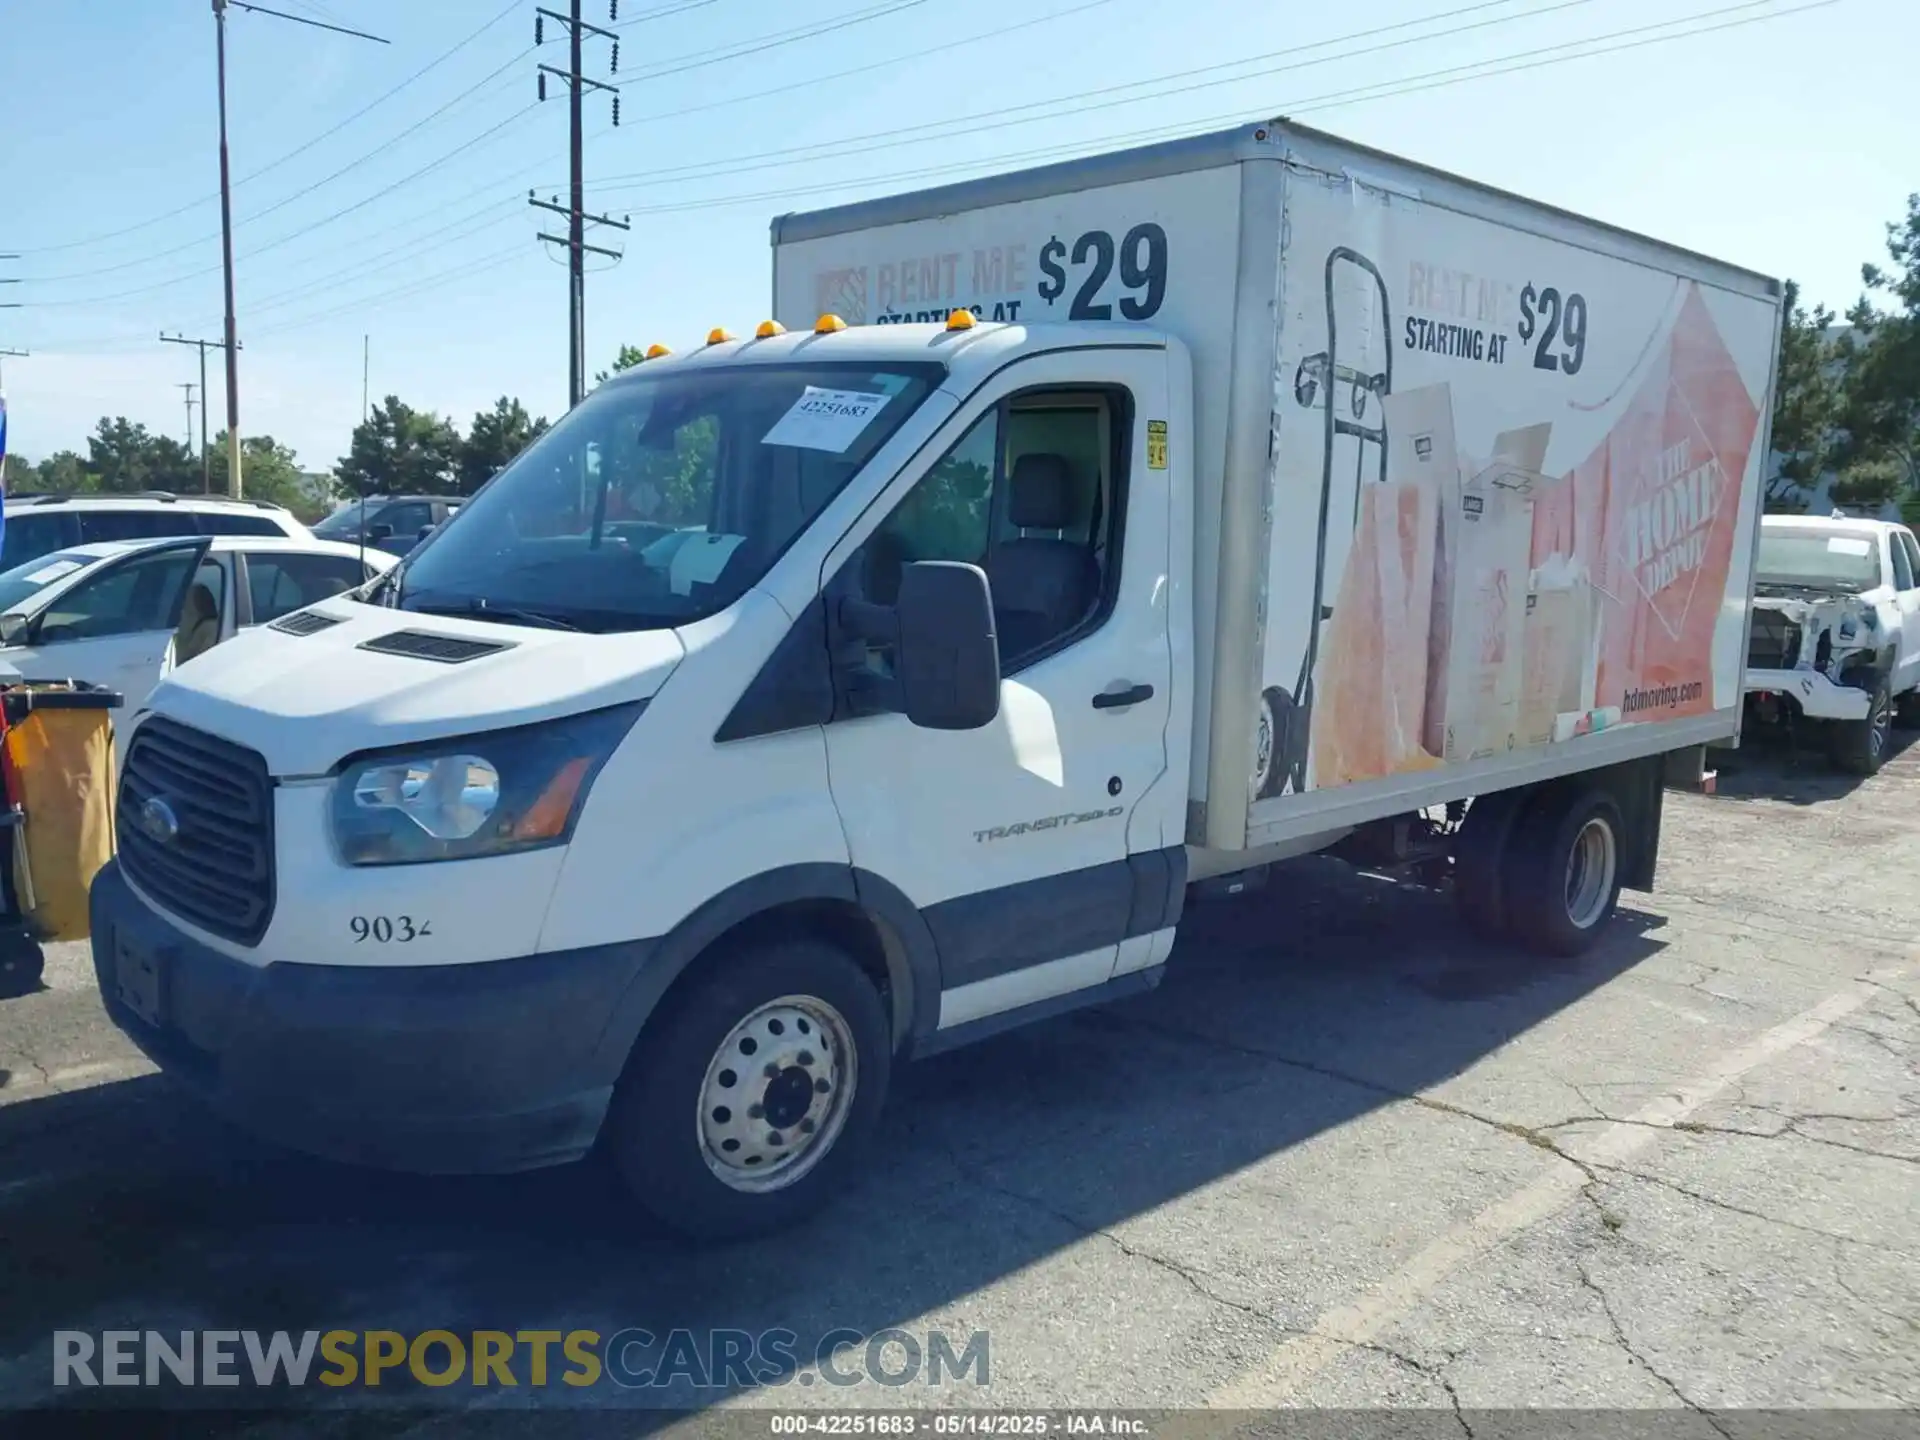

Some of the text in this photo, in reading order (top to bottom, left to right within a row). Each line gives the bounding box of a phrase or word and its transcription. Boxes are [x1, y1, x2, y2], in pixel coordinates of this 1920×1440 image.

[876, 244, 1027, 304] RENT ME
[1038, 223, 1168, 321] $29
[1405, 316, 1508, 364] STARTING AT
[1518, 281, 1587, 375] $29
[1626, 459, 1720, 572] HOME
[1623, 681, 1703, 713] hdmoving.com
